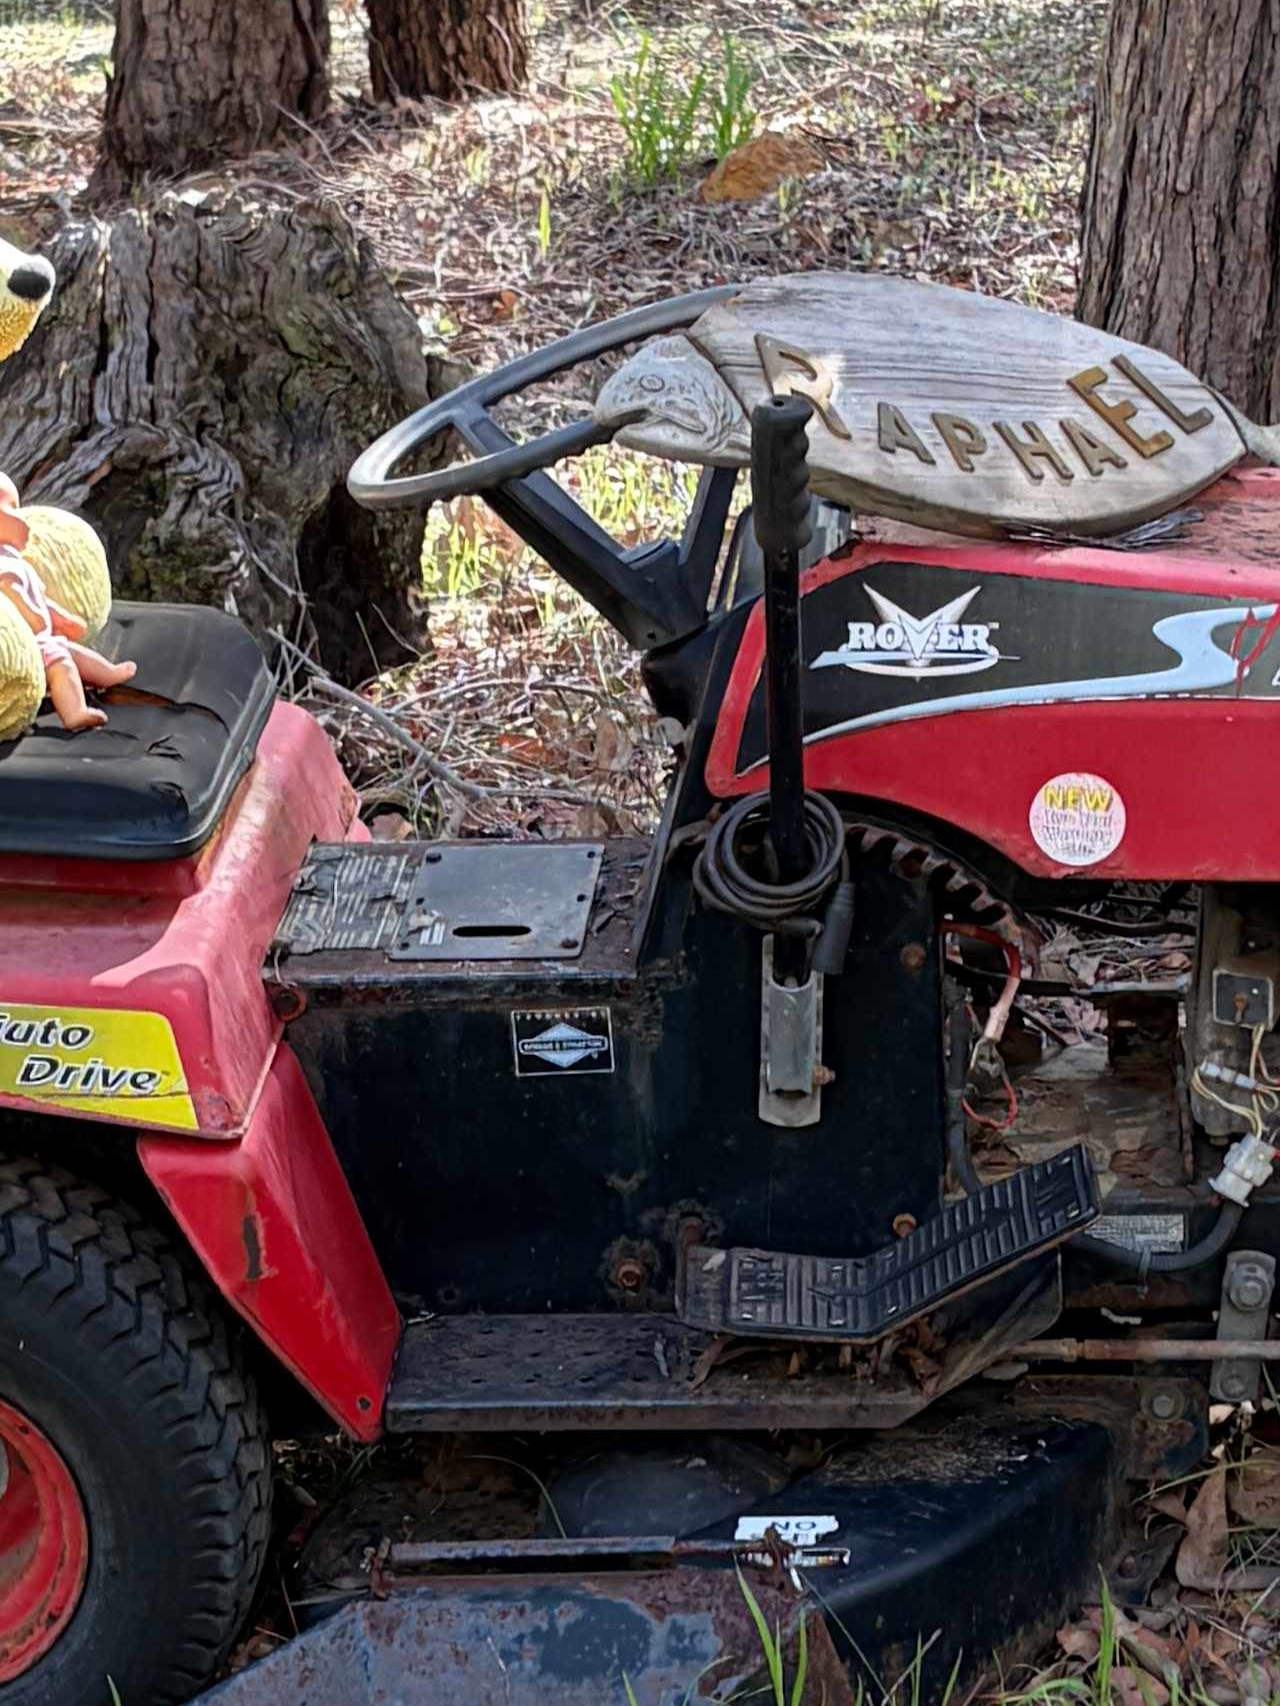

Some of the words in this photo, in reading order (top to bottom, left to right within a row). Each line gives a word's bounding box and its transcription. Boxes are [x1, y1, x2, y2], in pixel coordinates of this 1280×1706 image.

[753, 333, 1214, 480] RAPHAEL
[847, 613, 990, 663] ROVER
[1044, 784, 1114, 812] NEW
[16, 1053, 161, 1093] Drive
